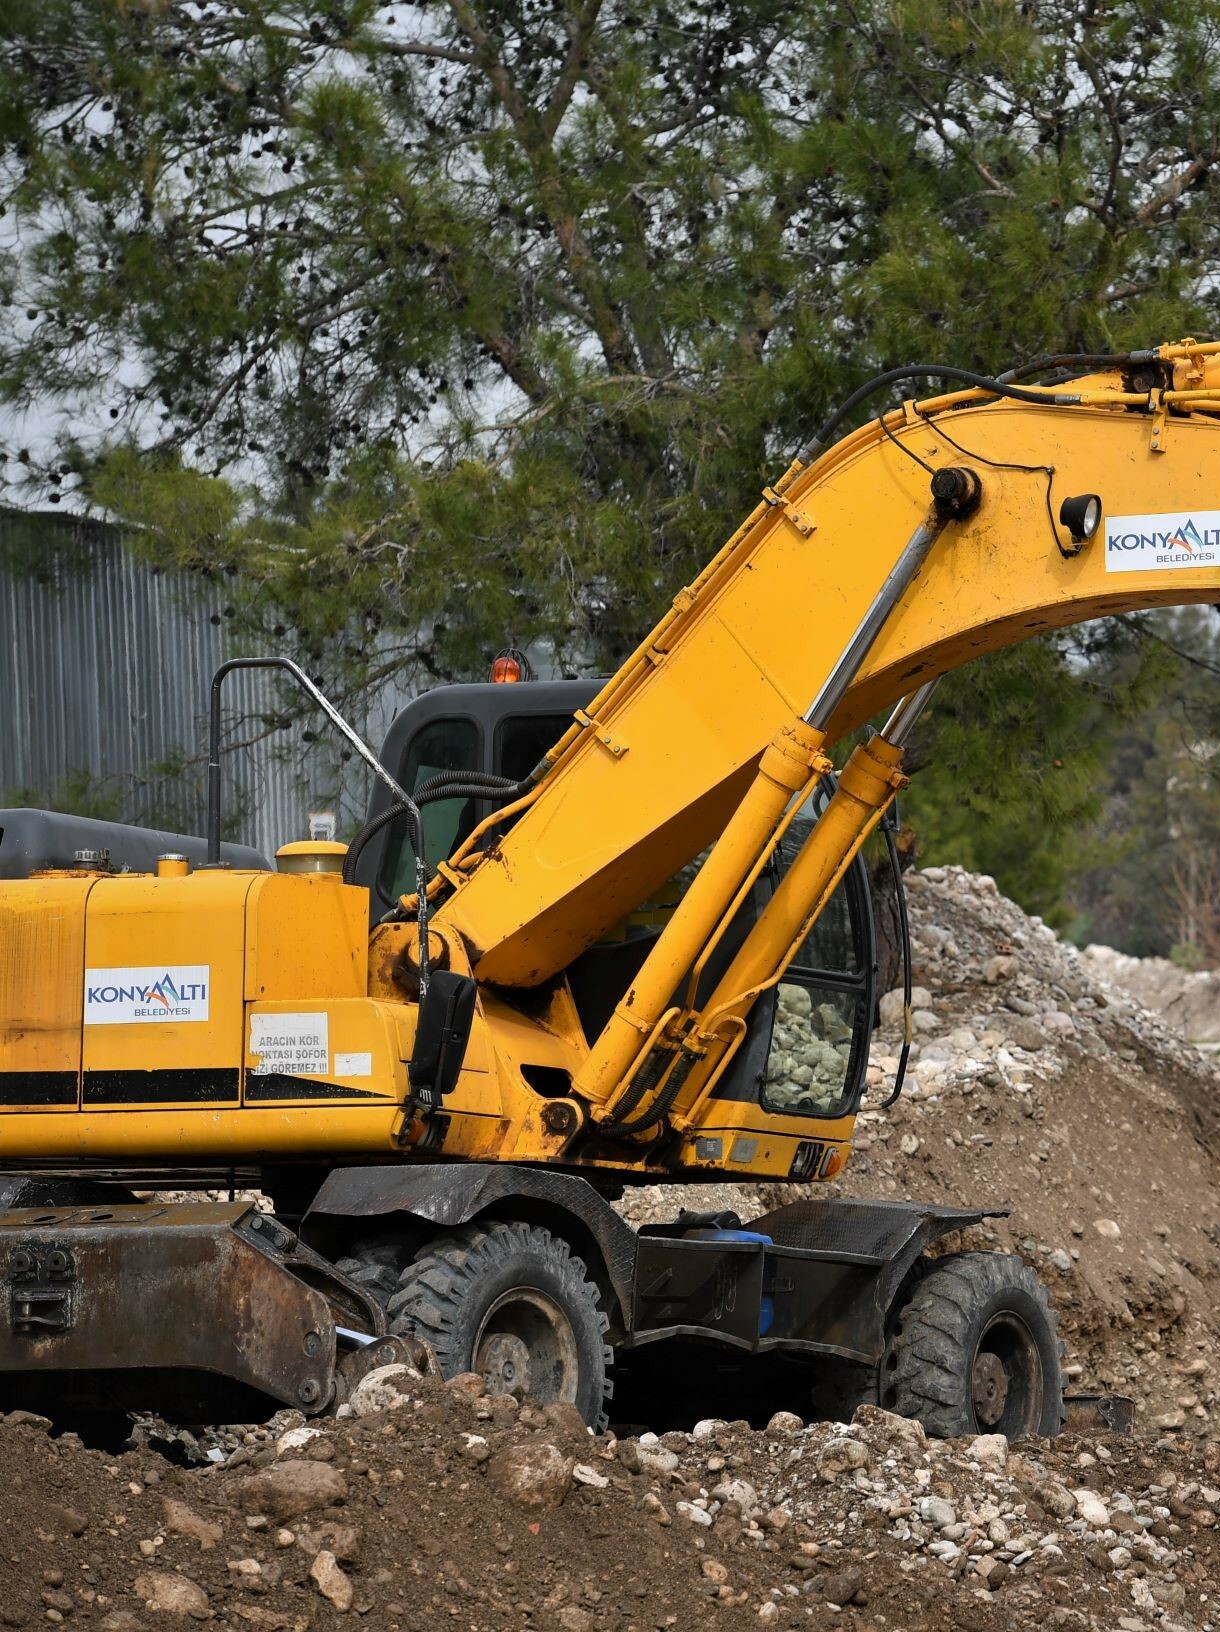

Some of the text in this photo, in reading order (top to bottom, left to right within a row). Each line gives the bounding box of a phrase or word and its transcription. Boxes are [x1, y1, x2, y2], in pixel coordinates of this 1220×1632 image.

[1156, 552, 1215, 563] BELEDİYESİ
[88, 973, 206, 1004] KONYAALTI
[134, 1007, 191, 1017] BELEDİYESİ
[259, 1034, 320, 1047] ARACIN KÖR
[271, 1061, 317, 1073] GÖREMEZ
